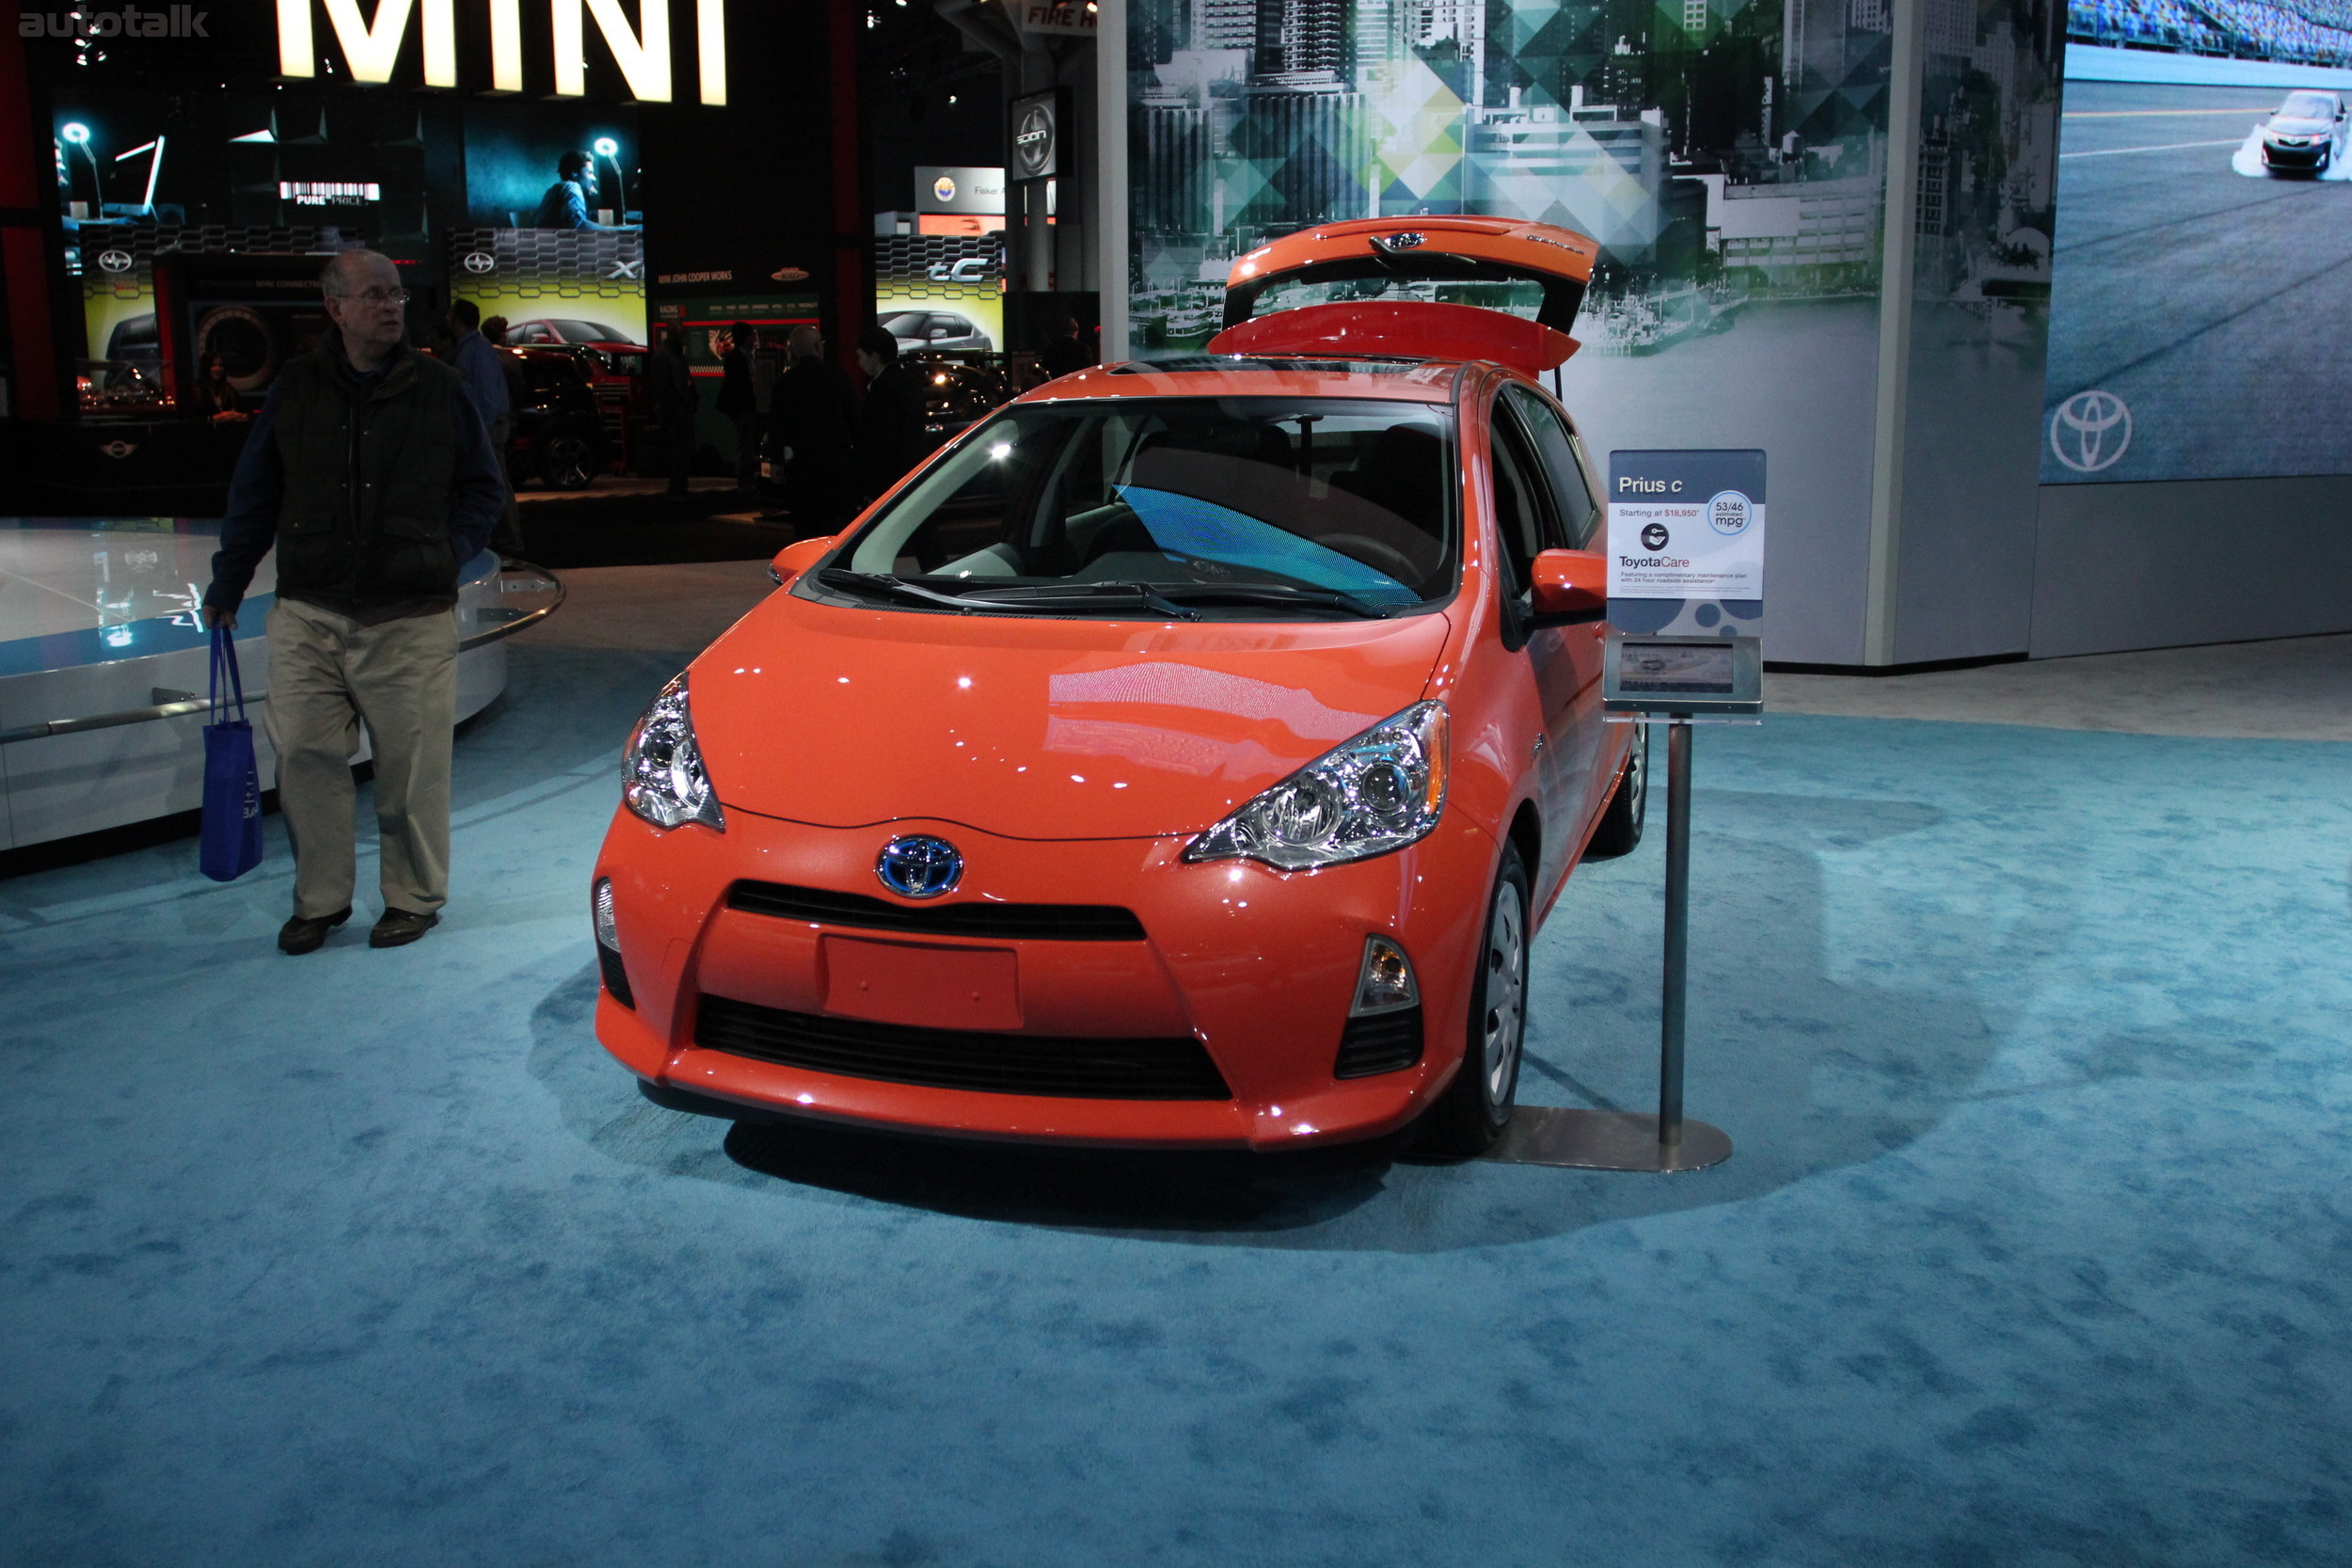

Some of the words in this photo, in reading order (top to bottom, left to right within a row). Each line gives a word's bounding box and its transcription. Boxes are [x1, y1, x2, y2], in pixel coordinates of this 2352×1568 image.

[1027, 6, 1074, 26] FIRE
[1079, 8, 1098, 28] H
[275, 0, 727, 106] MINI
[975, 186, 997, 195] Fisker
[295, 195, 326, 206] PURE
[688, 271, 710, 282] COOPER
[710, 270, 733, 281] WORKS
[927, 258, 989, 282] tC
[1619, 477, 1665, 493] Prius
[1671, 480, 1683, 493] c
[1715, 501, 1744, 512] 53/46
[1619, 509, 1652, 518] Starting
[1654, 509, 1662, 517] at
[1619, 556, 1690, 569] ToyotaCare
